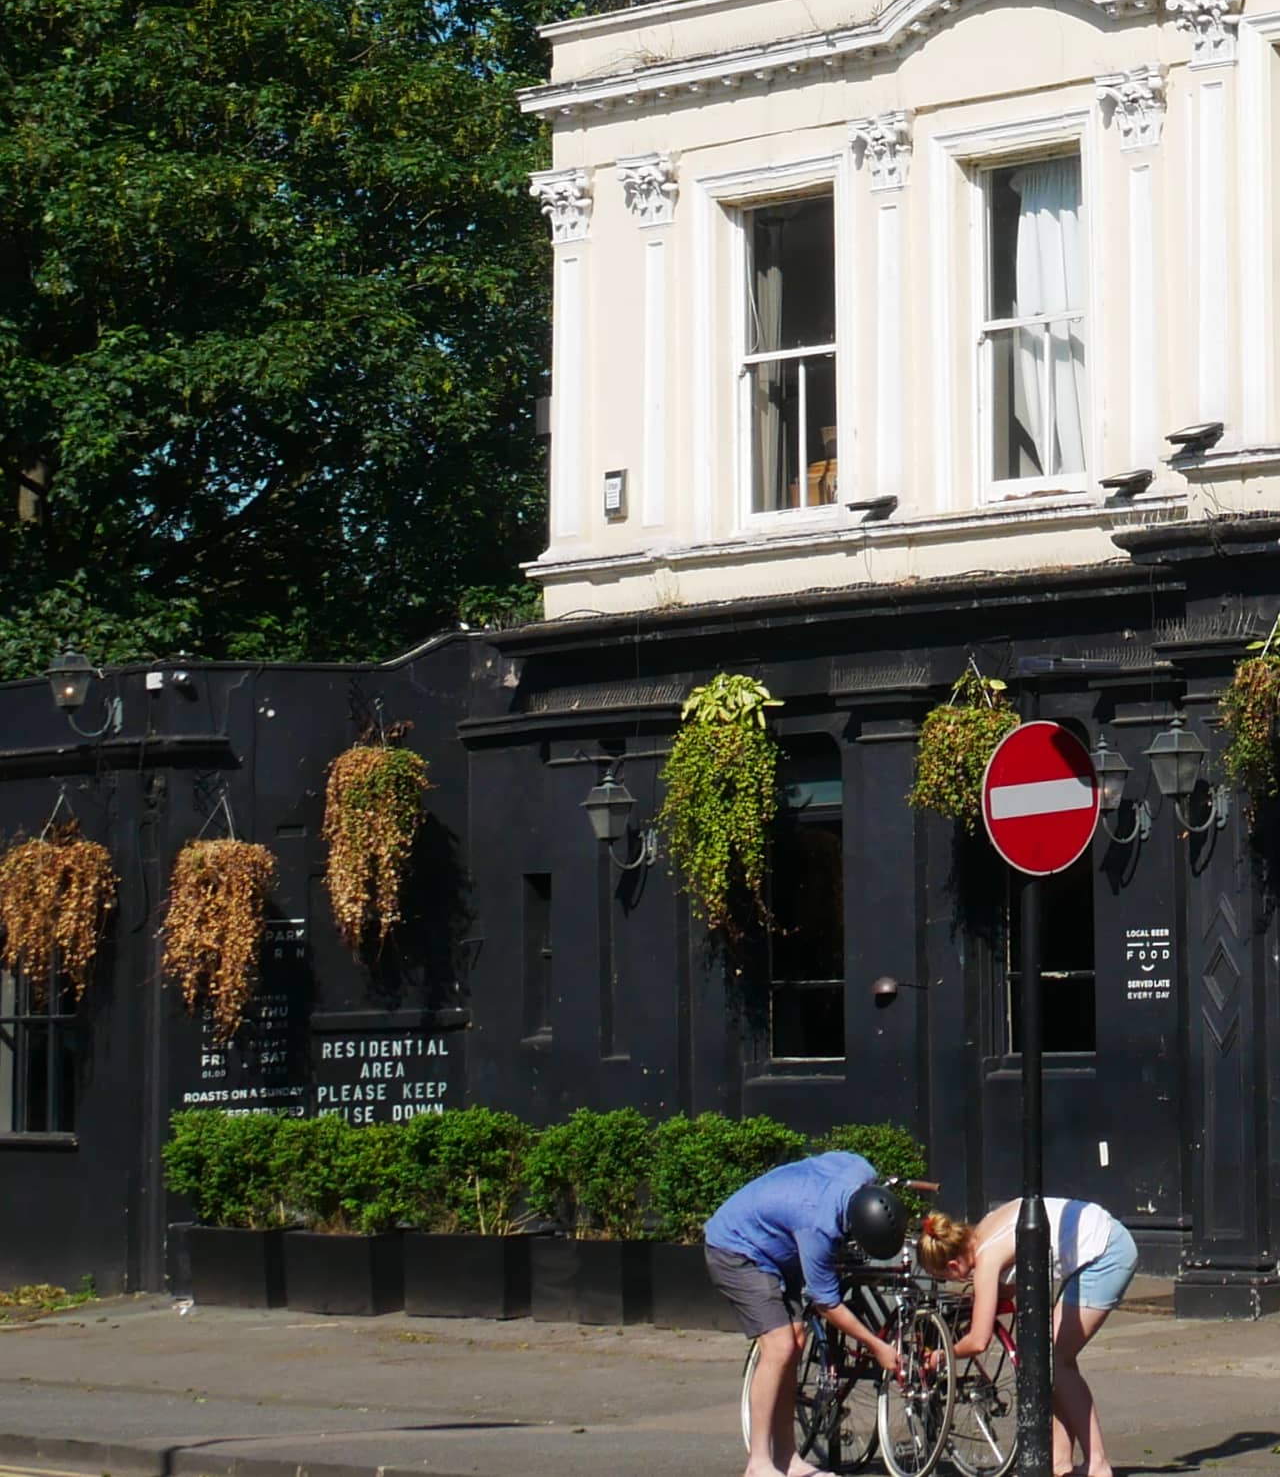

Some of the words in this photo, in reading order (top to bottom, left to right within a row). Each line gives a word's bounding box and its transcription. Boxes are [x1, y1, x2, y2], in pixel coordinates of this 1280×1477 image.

[1126, 930, 1150, 938] LOCAL
[1126, 949, 1170, 961] FOOD
[1127, 979, 1153, 989] SERVED
[1154, 979, 1171, 988] LATE
[1127, 991, 1153, 1000] EVERY
[1155, 991, 1170, 999] DAY
[260, 1006, 289, 1019] THU
[321, 1038, 449, 1060] RESIDENTIAL
[201, 1054, 226, 1067] FRI
[260, 1051, 288, 1064] SAT
[359, 1060, 406, 1079] AREA
[183, 1090, 229, 1103] ROASTS
[231, 1088, 248, 1100] ON
[249, 1087, 259, 1099] A
[260, 1085, 304, 1098] SUNDAY
[317, 1083, 388, 1104] PLEASE
[402, 1081, 448, 1100] KEEP
